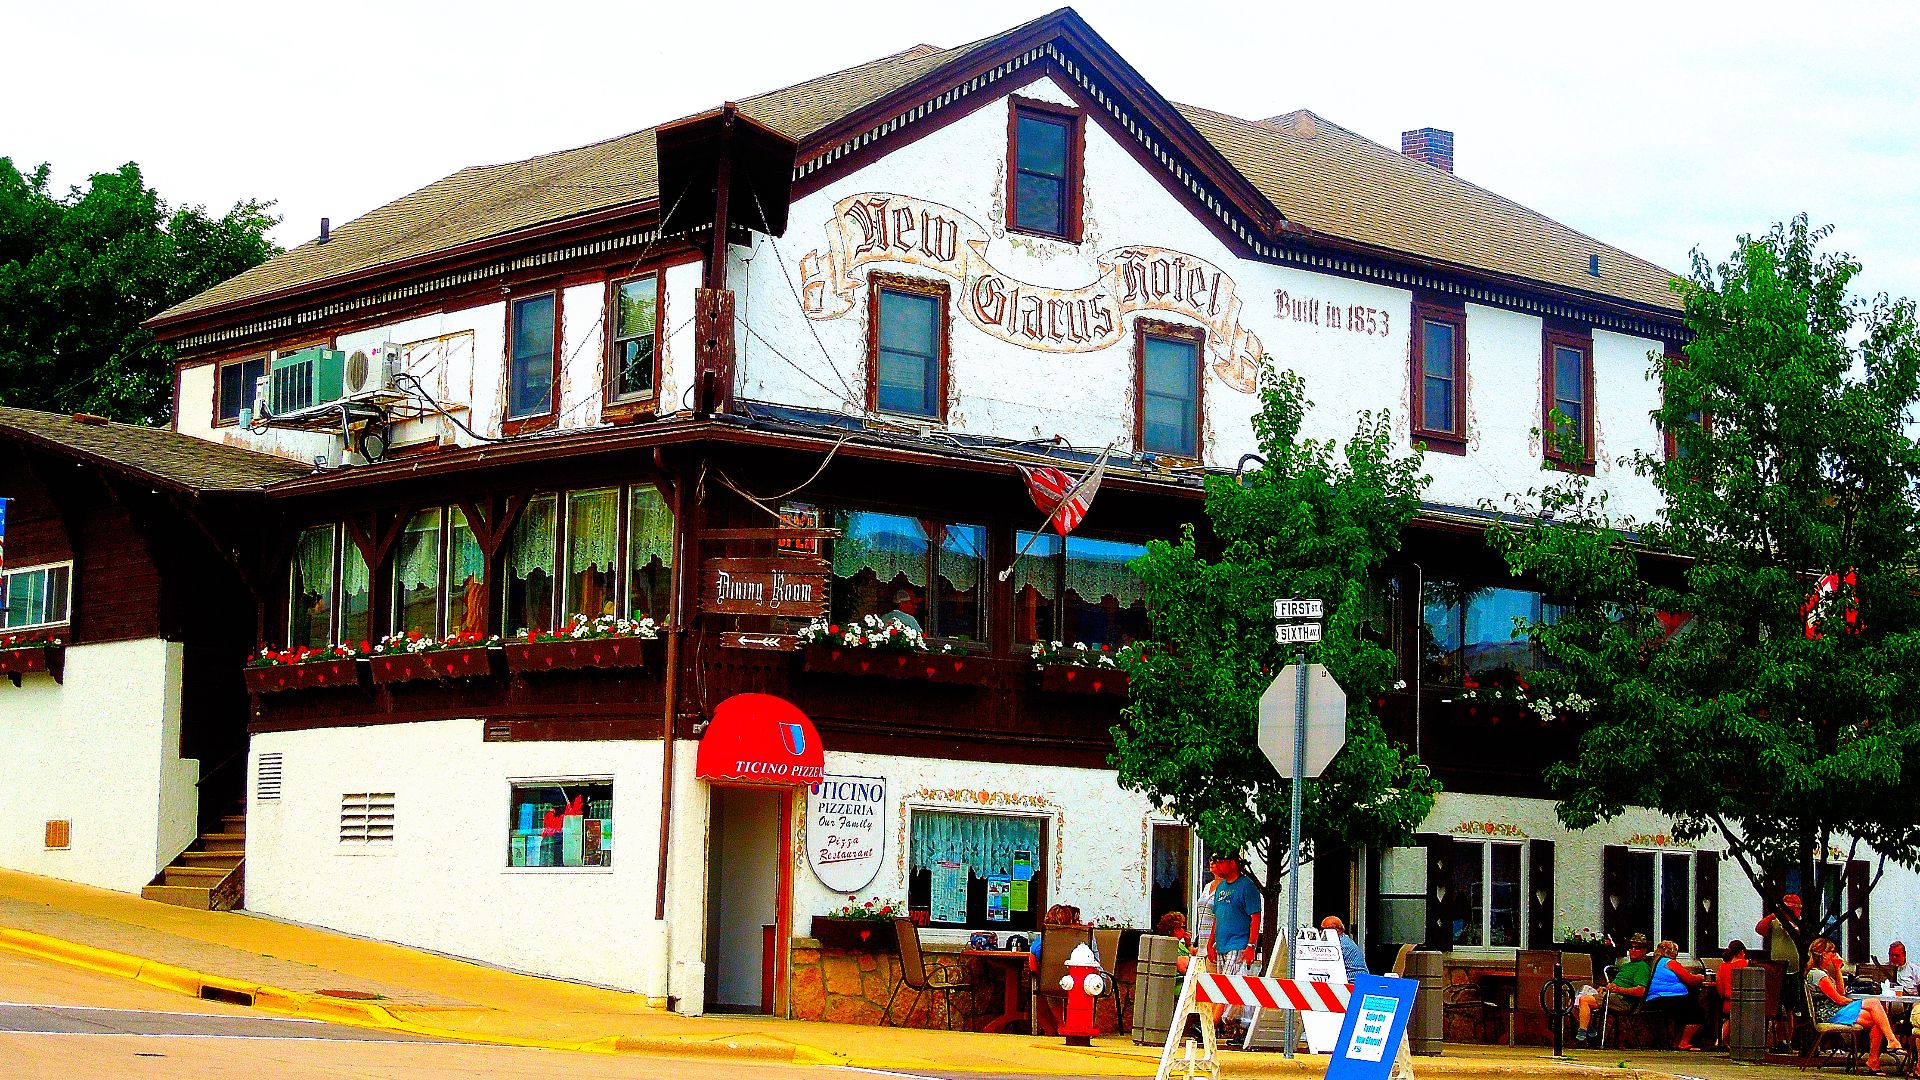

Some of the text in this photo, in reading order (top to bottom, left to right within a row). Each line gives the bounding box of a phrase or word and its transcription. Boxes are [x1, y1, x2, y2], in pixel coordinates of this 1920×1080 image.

[844, 197, 957, 263] New
[1120, 249, 1221, 318] Hotel
[971, 273, 1113, 344] Glarus
[1273, 288, 1390, 338] Built in 1853
[716, 569, 812, 609] Dining Room
[1281, 603, 1310, 615] FIRST
[1281, 627, 1309, 640] SIXTH
[735, 760, 788, 775] TICINO
[822, 781, 883, 803] TICINO
[818, 802, 874, 816] PIZZERIA
[818, 816, 873, 831] Our Family
[827, 835, 859, 848] Pizza
[819, 849, 873, 861] Restaurant
